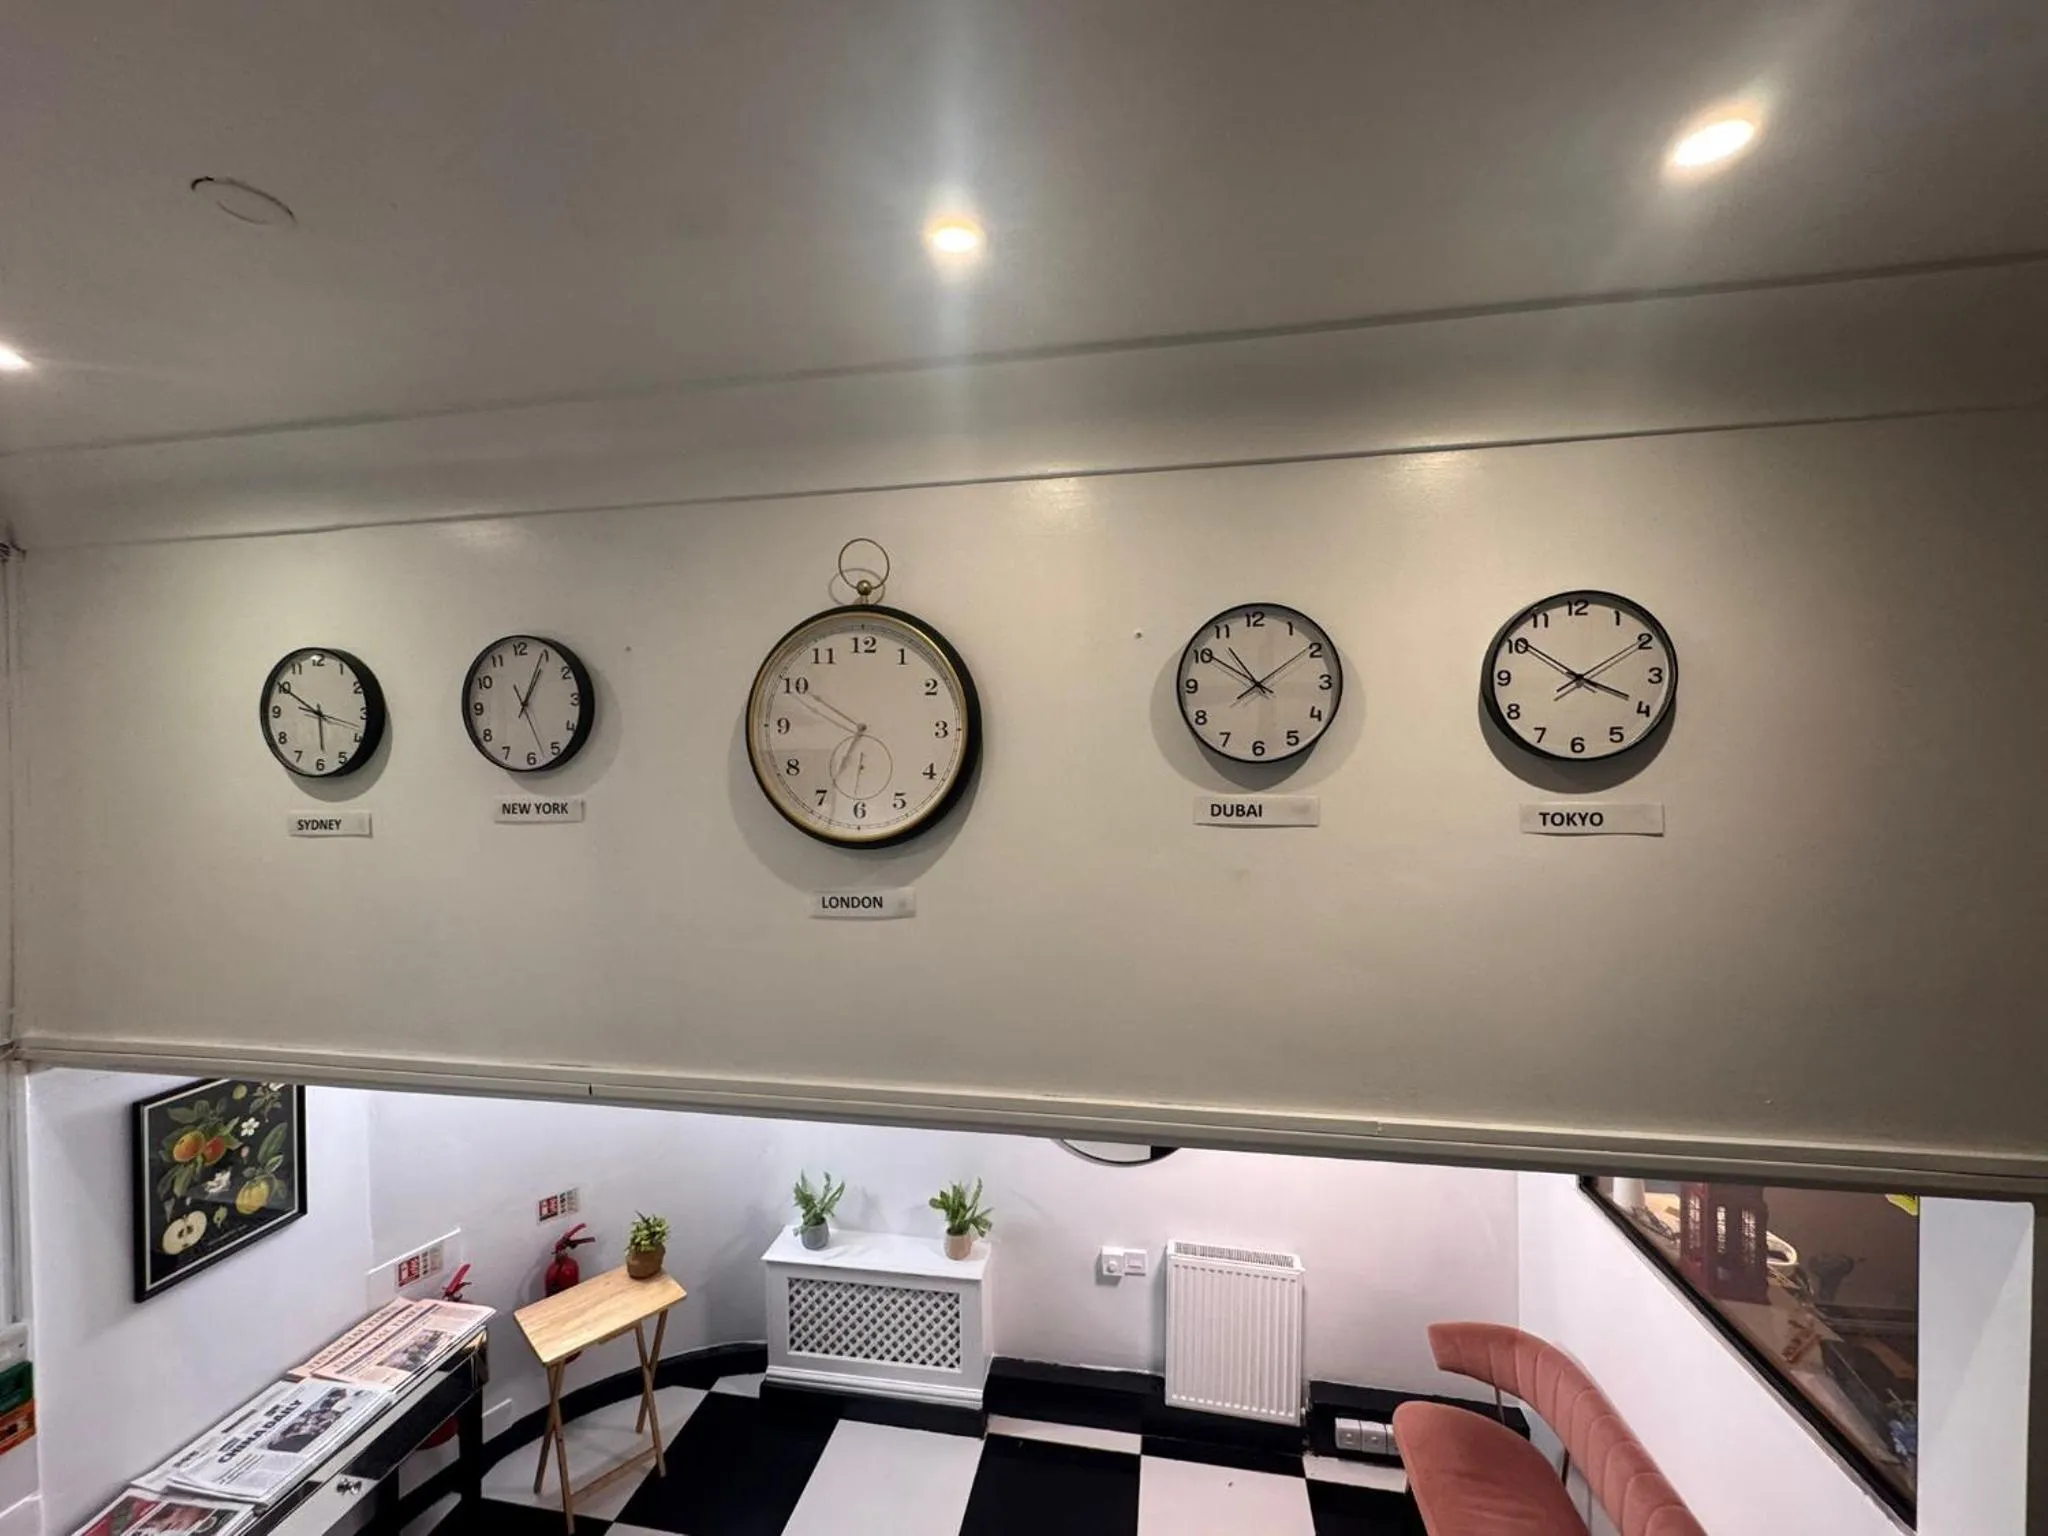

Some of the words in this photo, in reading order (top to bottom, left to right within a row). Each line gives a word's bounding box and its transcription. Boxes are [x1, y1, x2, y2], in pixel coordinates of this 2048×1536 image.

[1567, 600, 1588, 616] 12
[1246, 612, 1265, 627] 12
[1532, 613, 1548, 628] 11
[1615, 611, 1620, 626] 1
[1215, 624, 1229, 639] 11
[1287, 621, 1293, 636] 1
[513, 642, 528, 656] 12
[851, 637, 877, 654] 12
[1508, 638, 1529, 654] 10
[1638, 633, 1653, 650] 2
[812, 648, 836, 664] 11
[897, 648, 908, 665] 1
[1194, 648, 1212, 664] 10
[1309, 642, 1322, 658] 2
[492, 655, 503, 667] 11
[292, 663, 302, 675] 11
[561, 666, 571, 679] 2
[1648, 667, 1662, 684] 3
[479, 676, 493, 689] 10
[783, 677, 809, 694] 10
[1319, 674, 1332, 690] 3
[1497, 670, 1511, 686] 9
[353, 681, 362, 694] 2
[925, 679, 938, 696] 2
[1185, 679, 1198, 694] 9
[570, 693, 579, 706] 3
[272, 706, 281, 718] 9
[474, 703, 483, 716] 9
[1310, 706, 1322, 722] 4
[1507, 704, 1520, 720] 8
[1637, 701, 1650, 717] 4
[1195, 710, 1207, 725] 8
[566, 720, 575, 731] 4
[777, 717, 790, 734] 9
[934, 721, 948, 739] 3
[279, 732, 287, 744] 8
[483, 729, 493, 742] 8
[1220, 732, 1231, 747] 7
[1286, 730, 1299, 746] 5
[1534, 727, 1546, 743] 7
[1609, 726, 1624, 743] 5
[551, 742, 560, 755] 5
[1252, 741, 1265, 756] 6
[1571, 737, 1585, 753] 6
[294, 751, 303, 762] 7
[338, 752, 347, 763] 5
[502, 747, 511, 760] 7
[526, 752, 536, 765] 6
[316, 759, 325, 771] 6
[786, 759, 800, 776] 8
[922, 762, 936, 780] 4
[815, 789, 827, 806] 7
[893, 792, 906, 809] 5
[502, 802, 531, 815] NEW
[534, 802, 569, 815] YORK
[853, 802, 866, 819] 6
[1210, 803, 1263, 818] DUBAI
[297, 818, 342, 831] SYDNEY
[1538, 811, 1604, 827] TOKYO
[821, 895, 883, 909] LONDON
[218, 1430, 266, 1463] CHINA
[262, 1400, 302, 1429] DAILY
